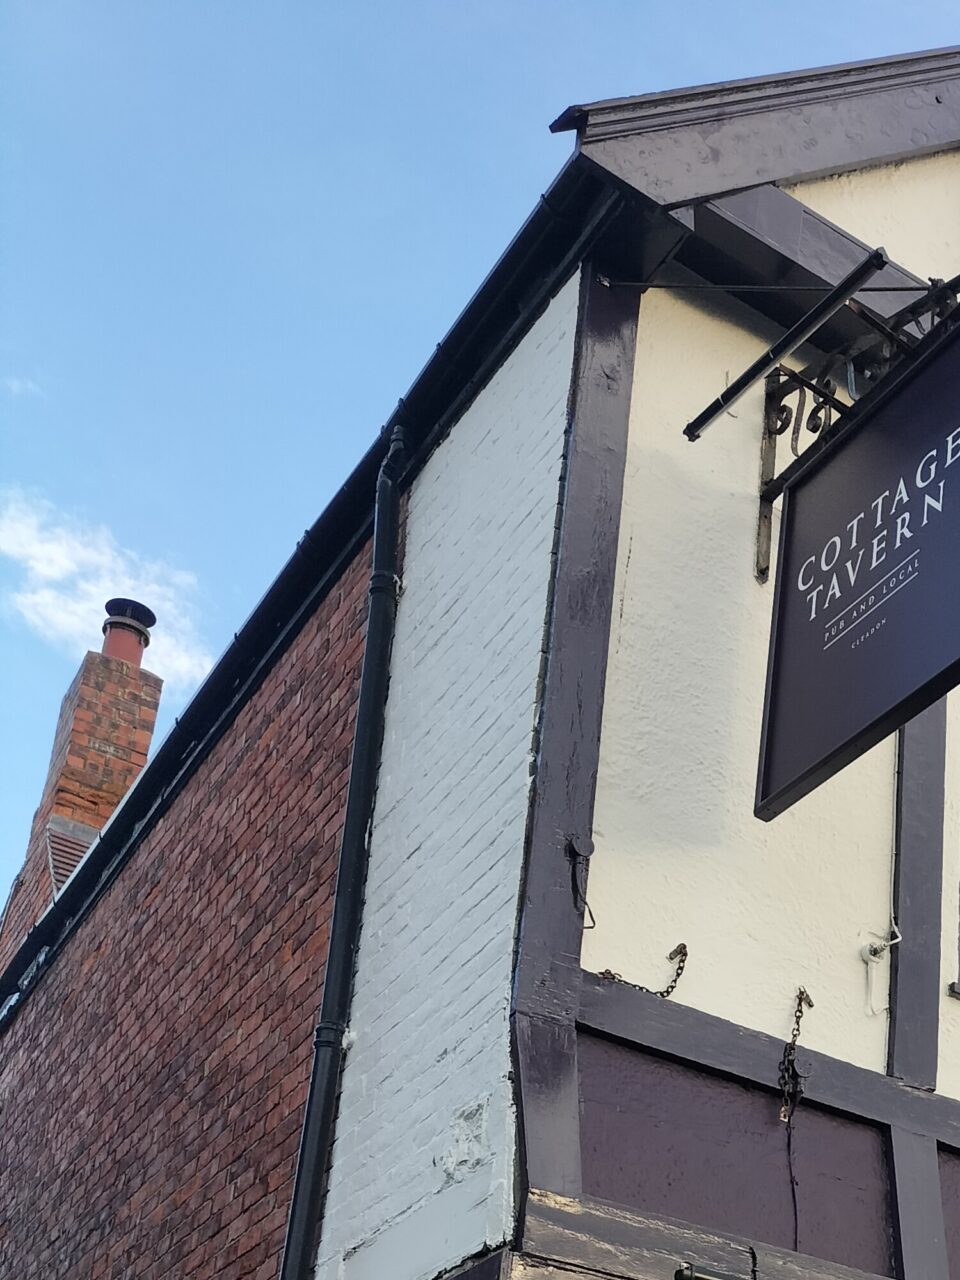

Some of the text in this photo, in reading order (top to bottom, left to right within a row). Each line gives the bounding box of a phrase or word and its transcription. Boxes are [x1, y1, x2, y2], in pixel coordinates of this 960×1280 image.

[806, 480, 946, 622] TAVERN
[824, 558, 920, 642] PUB AND LOCAL
[851, 617, 887, 649] CLEADON
